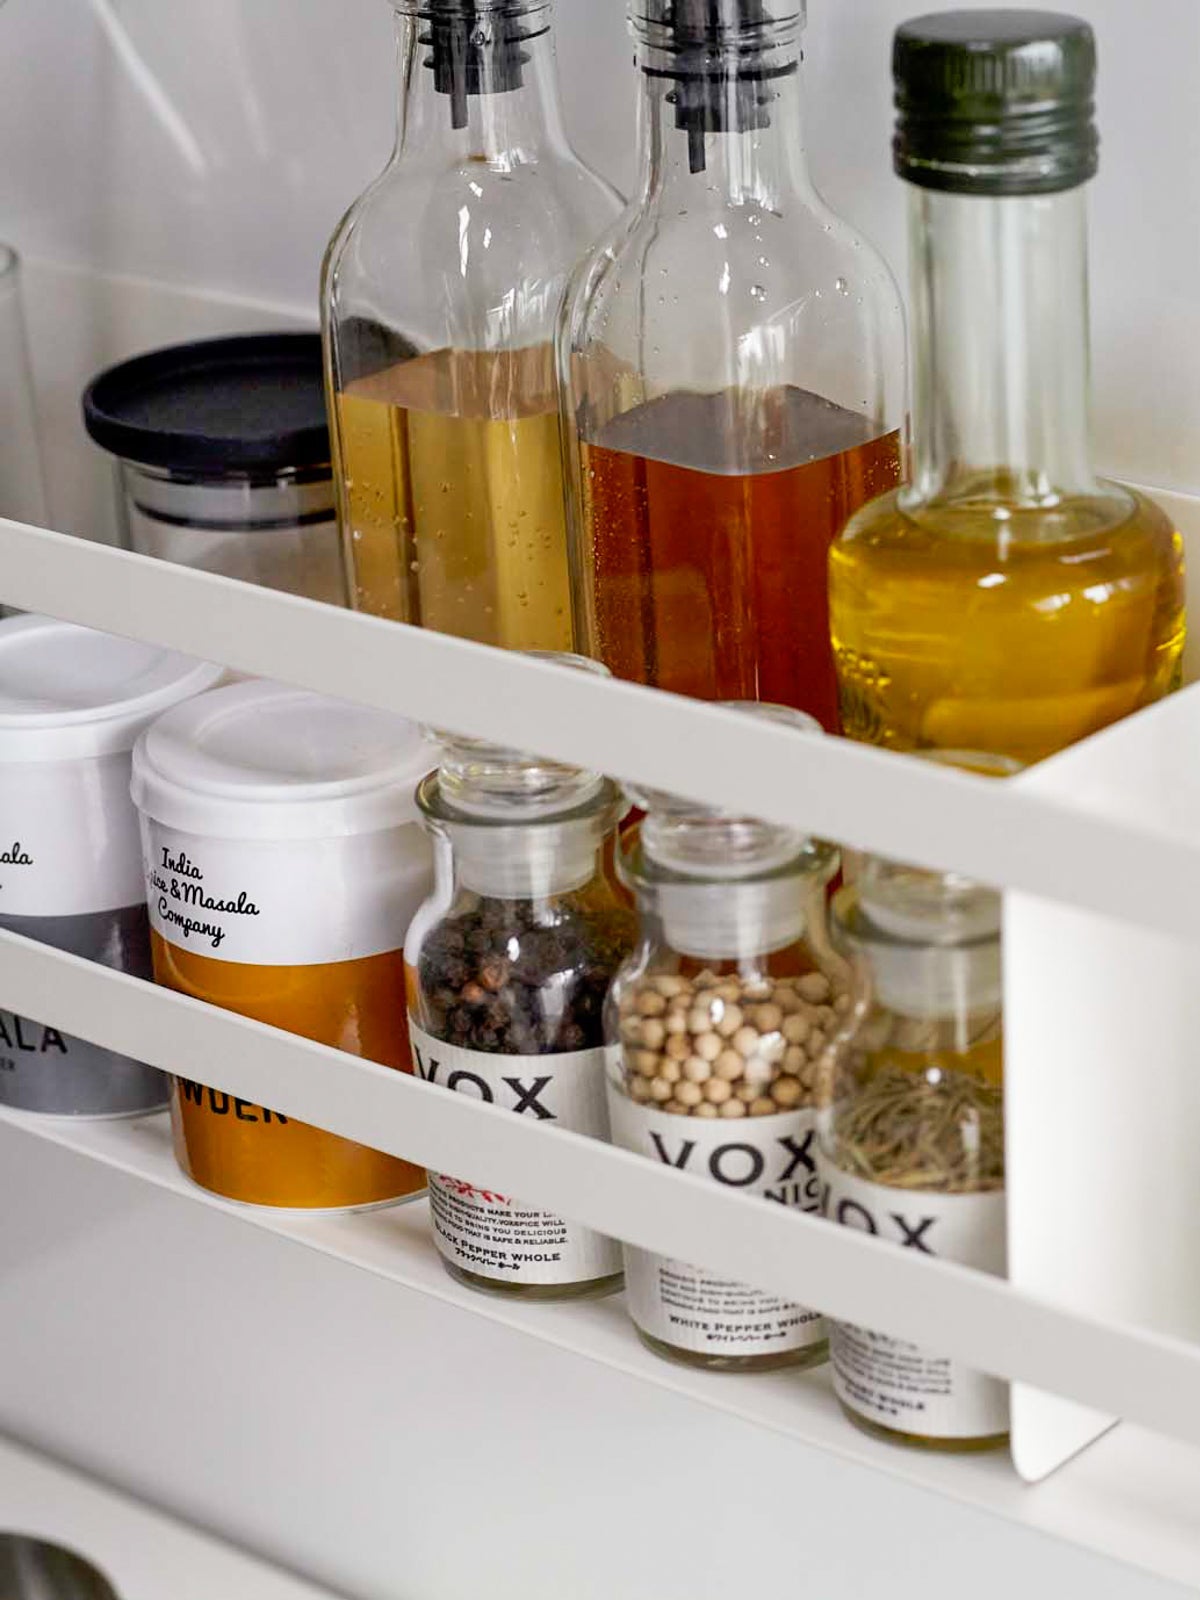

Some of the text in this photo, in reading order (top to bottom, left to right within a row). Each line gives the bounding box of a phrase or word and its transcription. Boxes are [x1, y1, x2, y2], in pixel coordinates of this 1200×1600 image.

[0, 841, 34, 866] ala
[162, 847, 203, 880] India
[170, 878, 182, 901] &
[181, 882, 260, 915] Masala
[158, 896, 225, 948] Company
[414, 1046, 557, 1120] VOX
[648, 1129, 817, 1187] VOX
[514, 1211, 539, 1219] YOUR
[493, 1226, 511, 1235] YOU
[513, 1227, 567, 1237] DELICIOUS
[460, 1240, 507, 1260] PEPPER
[511, 1252, 561, 1262] WHOLE
[669, 1314, 709, 1332] WHITE
[714, 1322, 772, 1333] PEPPER
